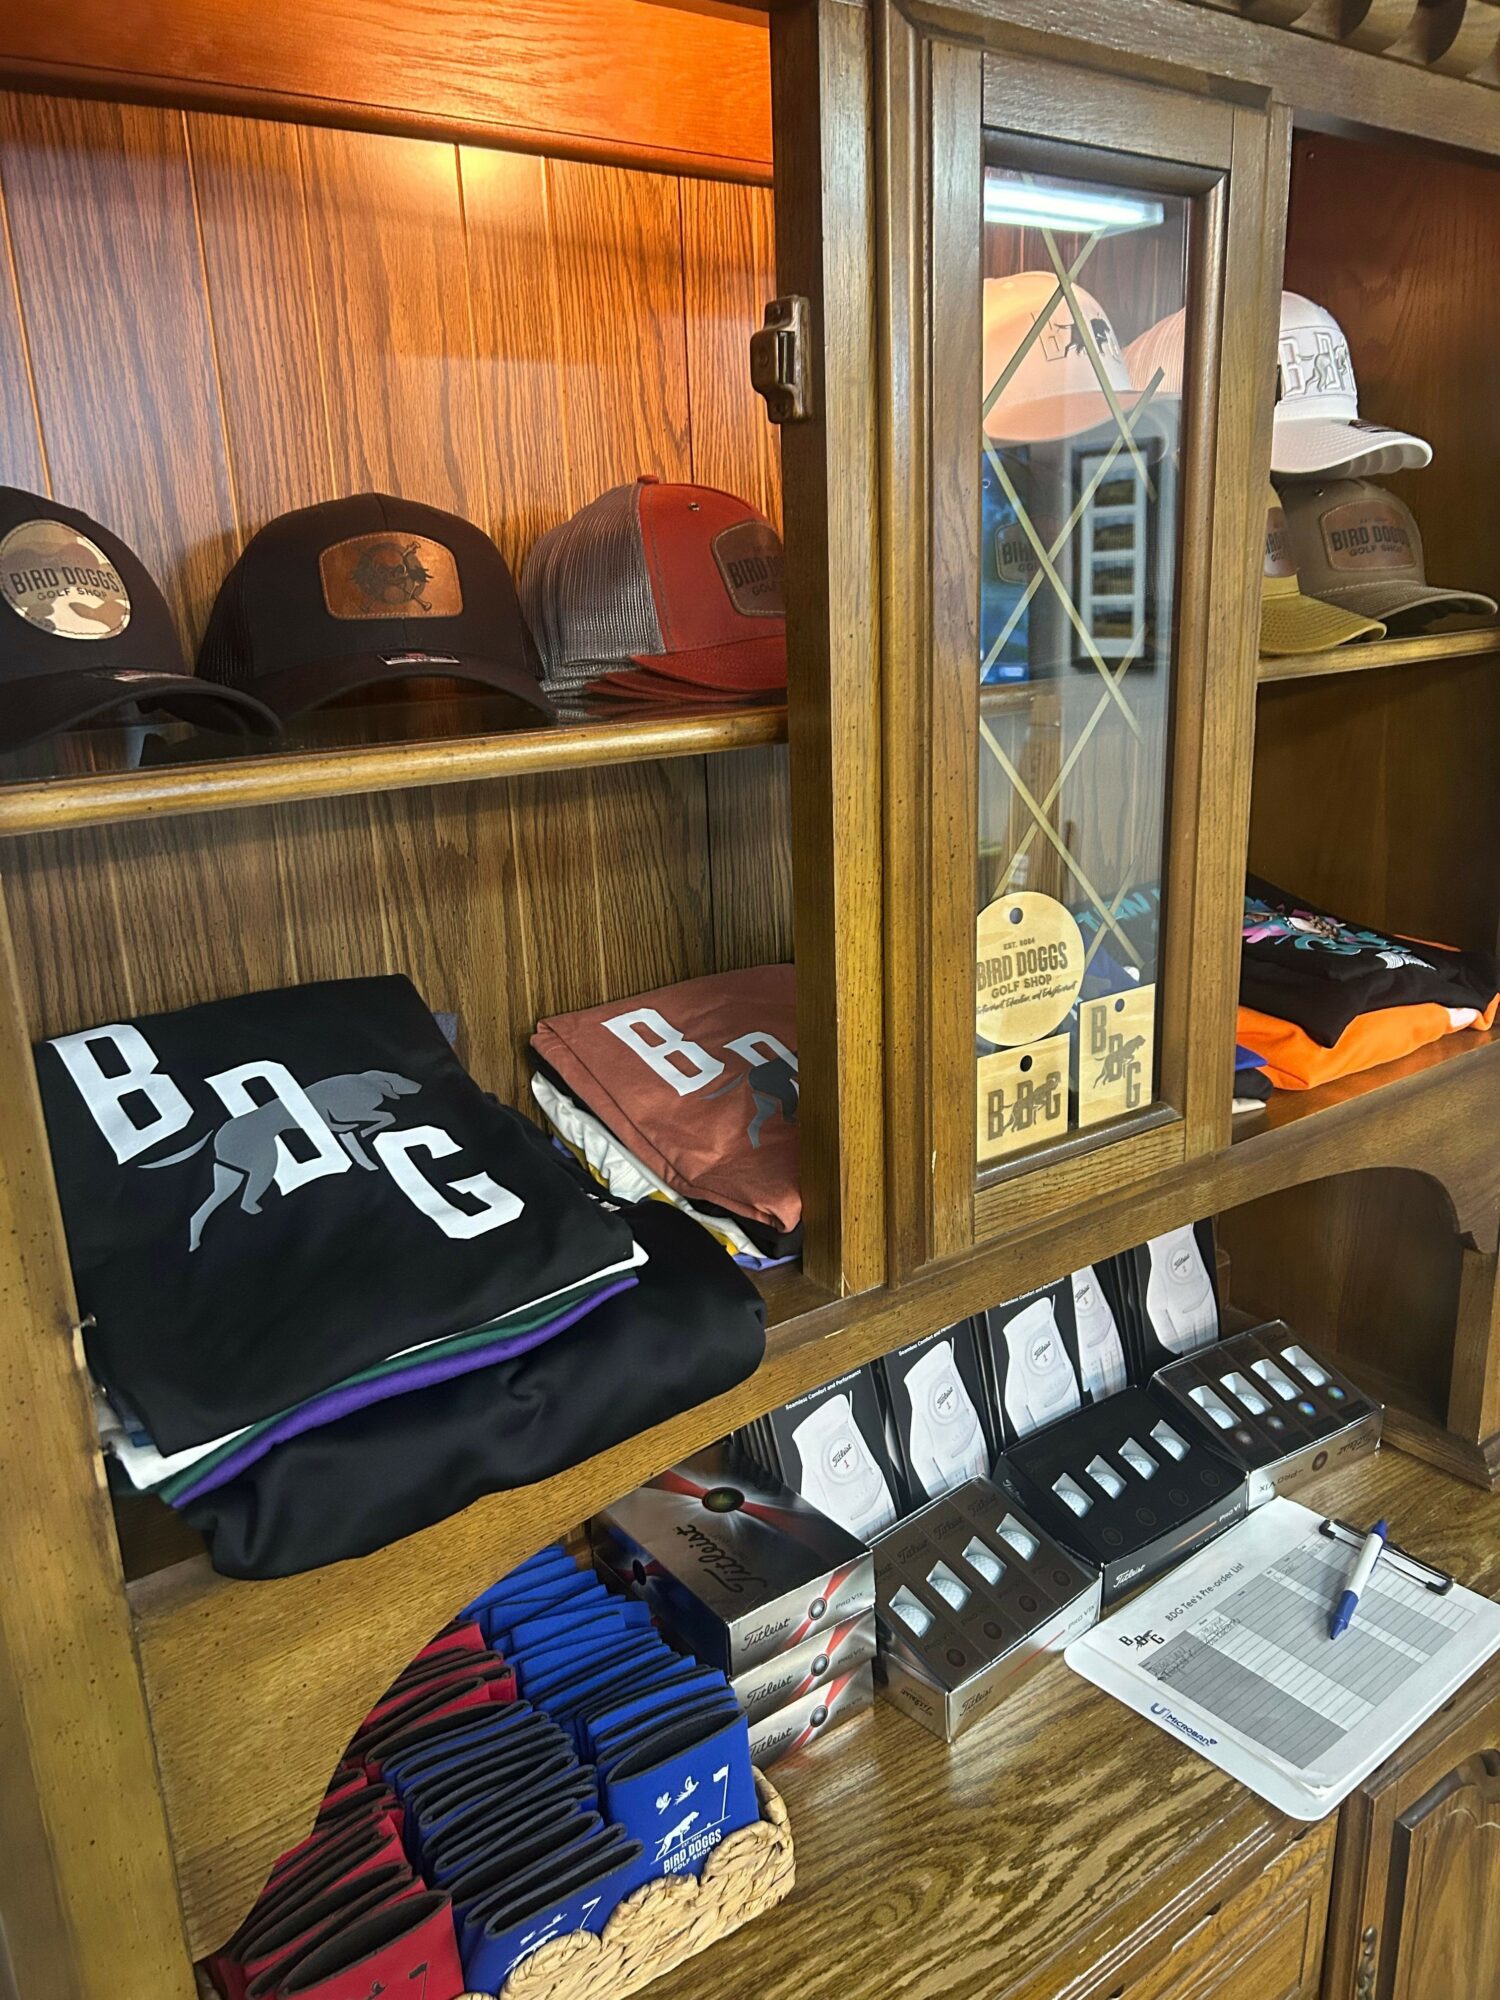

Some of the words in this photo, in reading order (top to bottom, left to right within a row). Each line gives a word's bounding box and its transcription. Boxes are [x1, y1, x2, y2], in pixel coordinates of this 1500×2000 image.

[1331, 526, 1369, 551] BIRD
[1349, 545, 1377, 557] GOLF
[9, 568, 59, 595] BIRD
[61, 566, 120, 592] DOGGS
[727, 557, 769, 589] BIRD
[37, 587, 70, 601] GOLF
[76, 587, 107, 598] SHOP
[976, 955, 1013, 991] BIRD
[1016, 941, 1068, 977] DOGGS
[991, 980, 1020, 999] GOLF
[1023, 974, 1052, 990] SHOP
[674, 1524, 768, 1593] Titleist
[1113, 1564, 1147, 1588] Titleist
[1165, 1607, 1184, 1622] BDG
[1180, 1595, 1203, 1611] Tee's
[1199, 1570, 1233, 1597] Pre-order
[741, 1617, 791, 1652] Titleist
[743, 1675, 794, 1709] Titleist
[959, 1685, 994, 1717] Titleist
[750, 1727, 794, 1758] Titleist
[663, 1849, 687, 1874] BIRD
[688, 1828, 722, 1857] DOGGS
[672, 1857, 691, 1874] GOLF
[692, 1847, 712, 1861] SHOP
